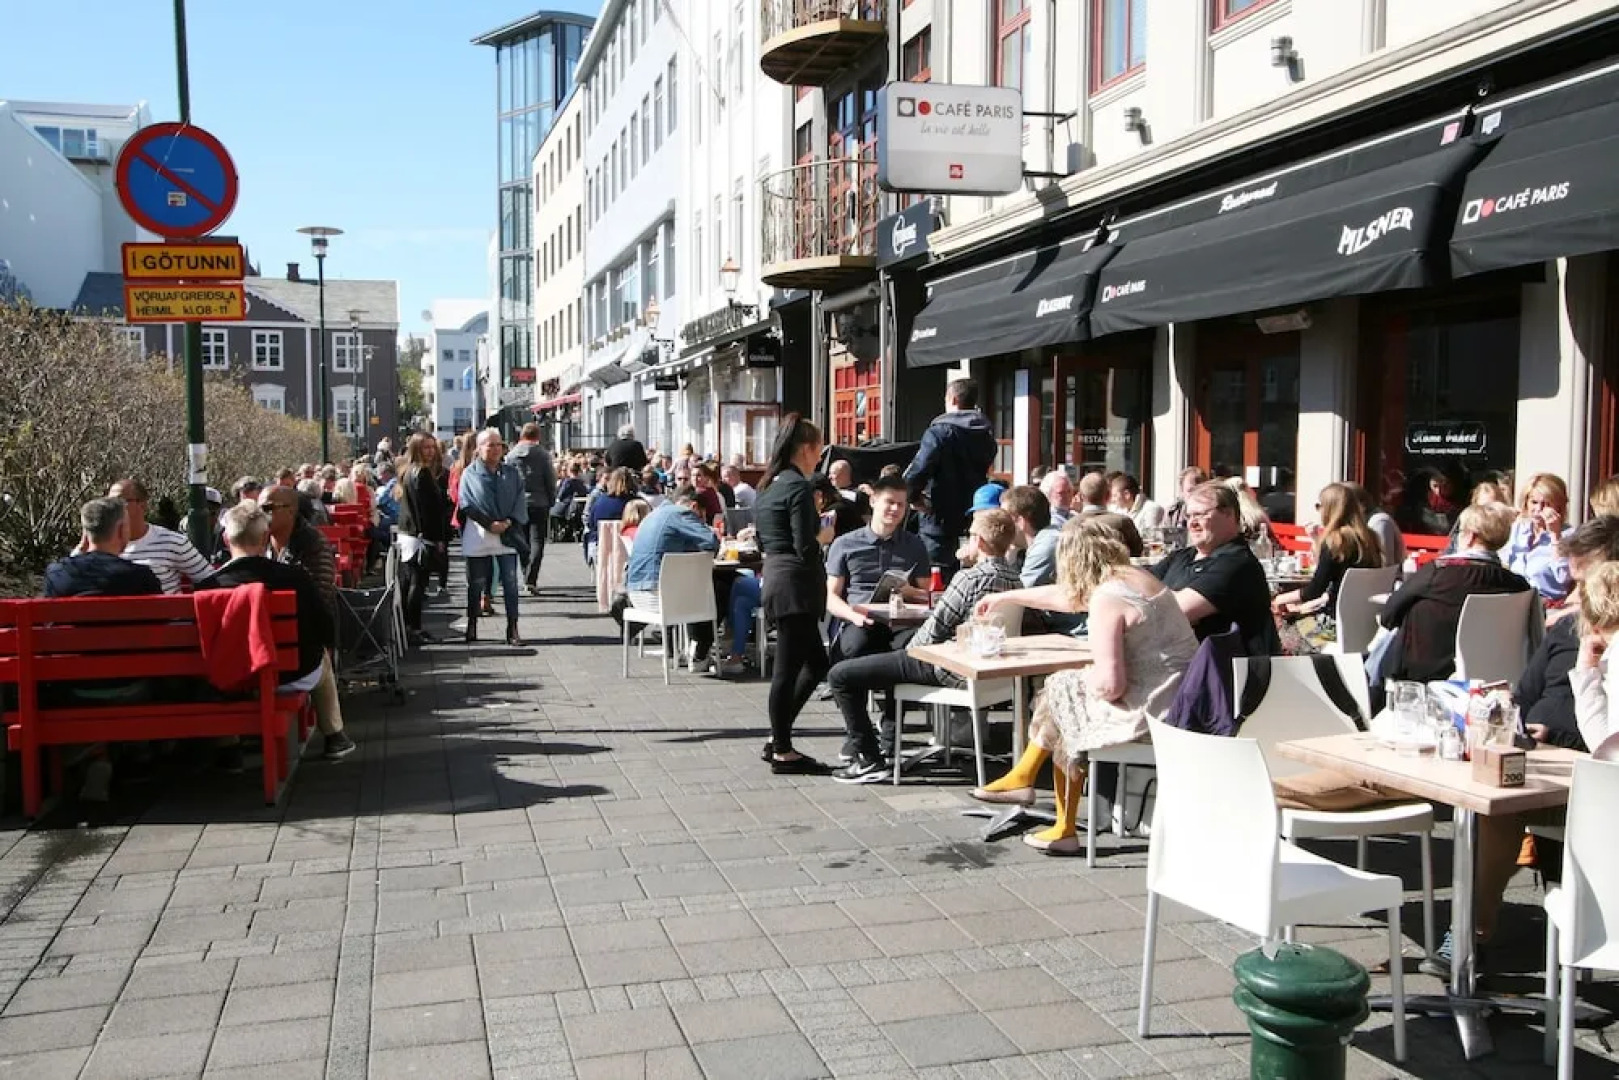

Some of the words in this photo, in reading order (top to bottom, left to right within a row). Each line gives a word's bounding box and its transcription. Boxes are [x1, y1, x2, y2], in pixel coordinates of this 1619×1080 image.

[935, 101, 971, 117] CAFÉ
[976, 104, 1014, 119] PARIS
[1495, 188, 1531, 213] CAFÉ
[1530, 181, 1571, 205] PARIS
[1337, 207, 1414, 255] PILSNER
[1504, 772, 1523, 783] 200
